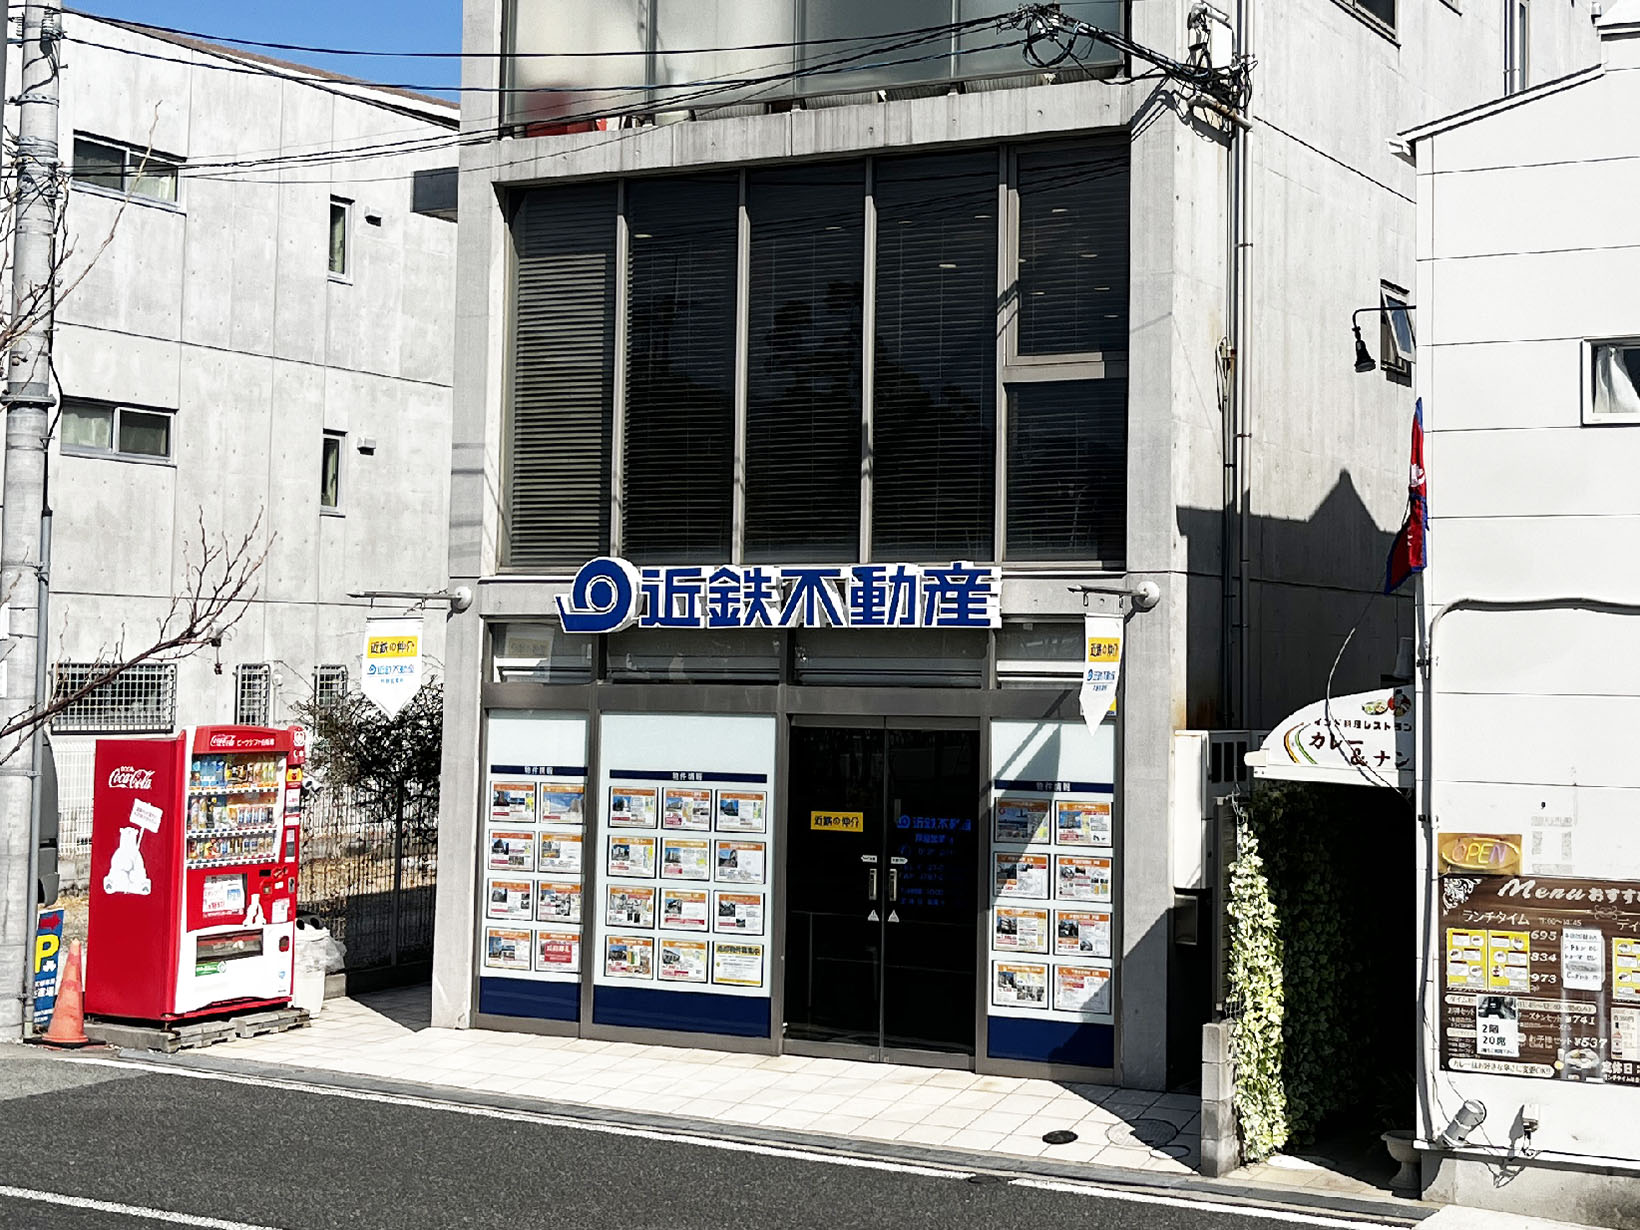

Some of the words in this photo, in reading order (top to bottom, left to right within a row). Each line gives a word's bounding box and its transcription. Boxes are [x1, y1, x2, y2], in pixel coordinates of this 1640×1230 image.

[640, 561, 993, 627] 近鉄不動産
[1452, 842, 1507, 864] OPEN
[1497, 878, 1586, 902] Menu
[1462, 909, 1530, 926] ランチタイム
[35, 934, 60, 974] P
